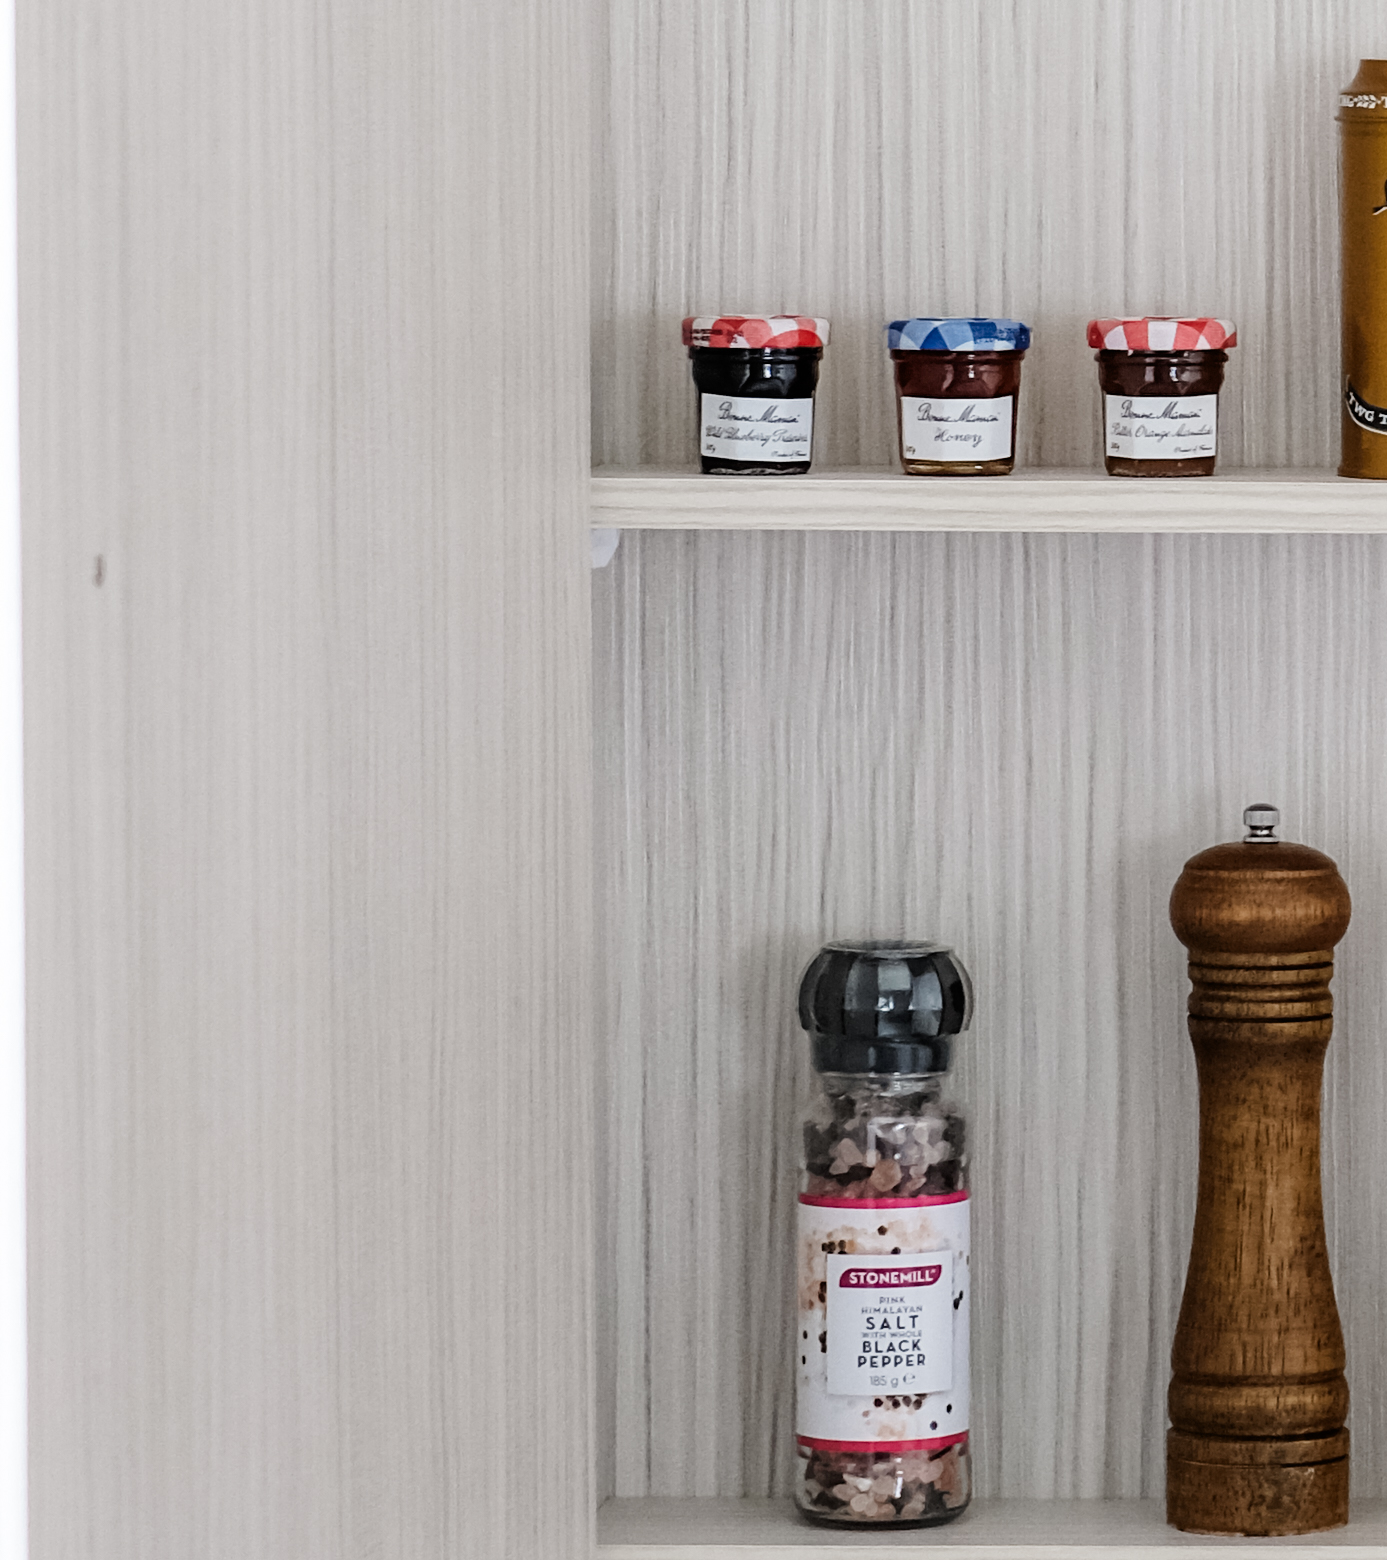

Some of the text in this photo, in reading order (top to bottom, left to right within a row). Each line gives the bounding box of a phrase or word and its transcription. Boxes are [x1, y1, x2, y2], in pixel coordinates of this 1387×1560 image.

[1349, 391, 1375, 422] TWG
[934, 427, 983, 448] Honey
[849, 1269, 934, 1285] STONEMILL
[879, 1296, 905, 1304] PINK
[861, 1306, 923, 1314] HIMALAYAN
[866, 1315, 919, 1330] SALT
[862, 1338, 922, 1353] BLACK
[857, 1353, 926, 1368] PEPPER
